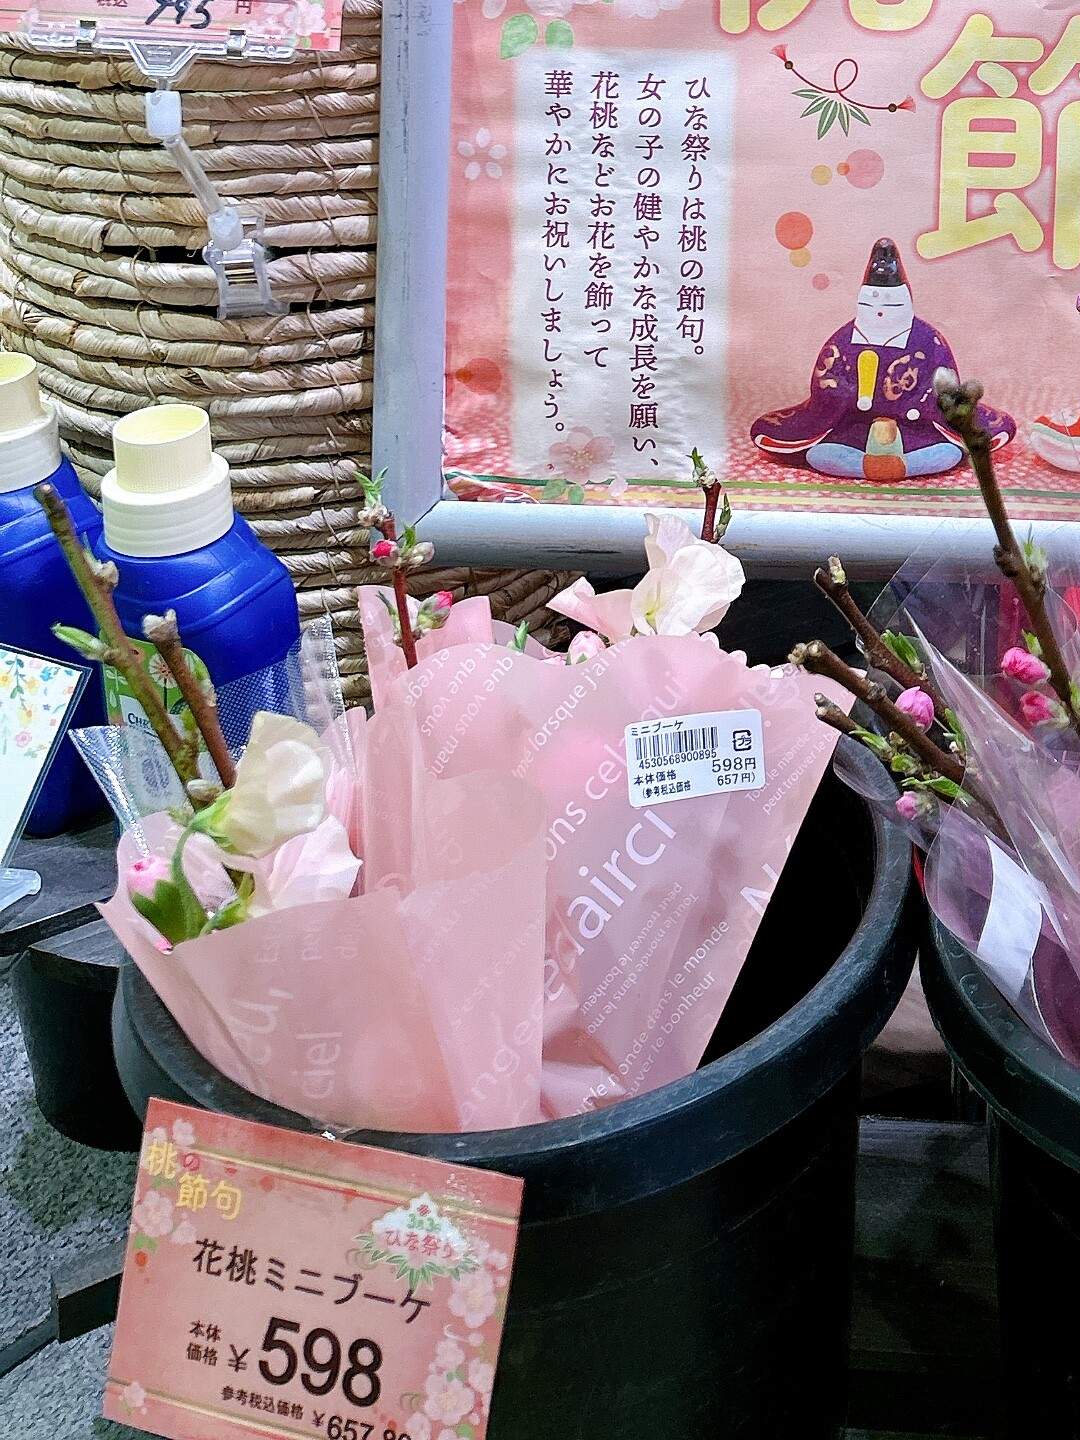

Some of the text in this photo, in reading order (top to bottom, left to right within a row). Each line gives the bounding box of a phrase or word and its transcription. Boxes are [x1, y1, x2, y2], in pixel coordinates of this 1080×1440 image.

[583, 70, 620, 369] 花桃などお花を飾って
[676, 77, 711, 356] ひな祭りは桃の節句。
[540, 70, 573, 433] 華やかにお祝いしましょう。
[629, 72, 667, 467] 女の子の健やかな成長を願い、
[420, 657, 477, 737] que vous
[454, 655, 514, 736] que vous
[530, 683, 587, 752] lorsque
[631, 720, 684, 737] ミニブーケ
[633, 757, 757, 786] 本体価格 598円
[638, 748, 717, 771] 4530568900895
[779, 734, 808, 768] monde
[762, 787, 786, 815] peut
[784, 752, 818, 789] trouver
[815, 740, 826, 755] le
[664, 912, 678, 930] le
[676, 892, 701, 919] Tout
[581, 882, 684, 1017] peut trouver le bonheur
[635, 929, 667, 971] monde
[613, 971, 639, 1001] dans
[646, 988, 673, 1030] dans
[668, 972, 686, 990] le
[683, 919, 731, 974] monde
[602, 997, 619, 1014] le
[651, 970, 717, 1054] le bonheur
[146, 1138, 200, 1178] 桃の
[175, 1172, 244, 1221] 節句
[384, 1228, 455, 1260] ひな祭り
[192, 1236, 432, 1324] 花桃ミニブーケ
[188, 1320, 222, 1342] 本体
[186, 1342, 218, 1367] 価格
[221, 1385, 304, 1420] 参考税込価格
